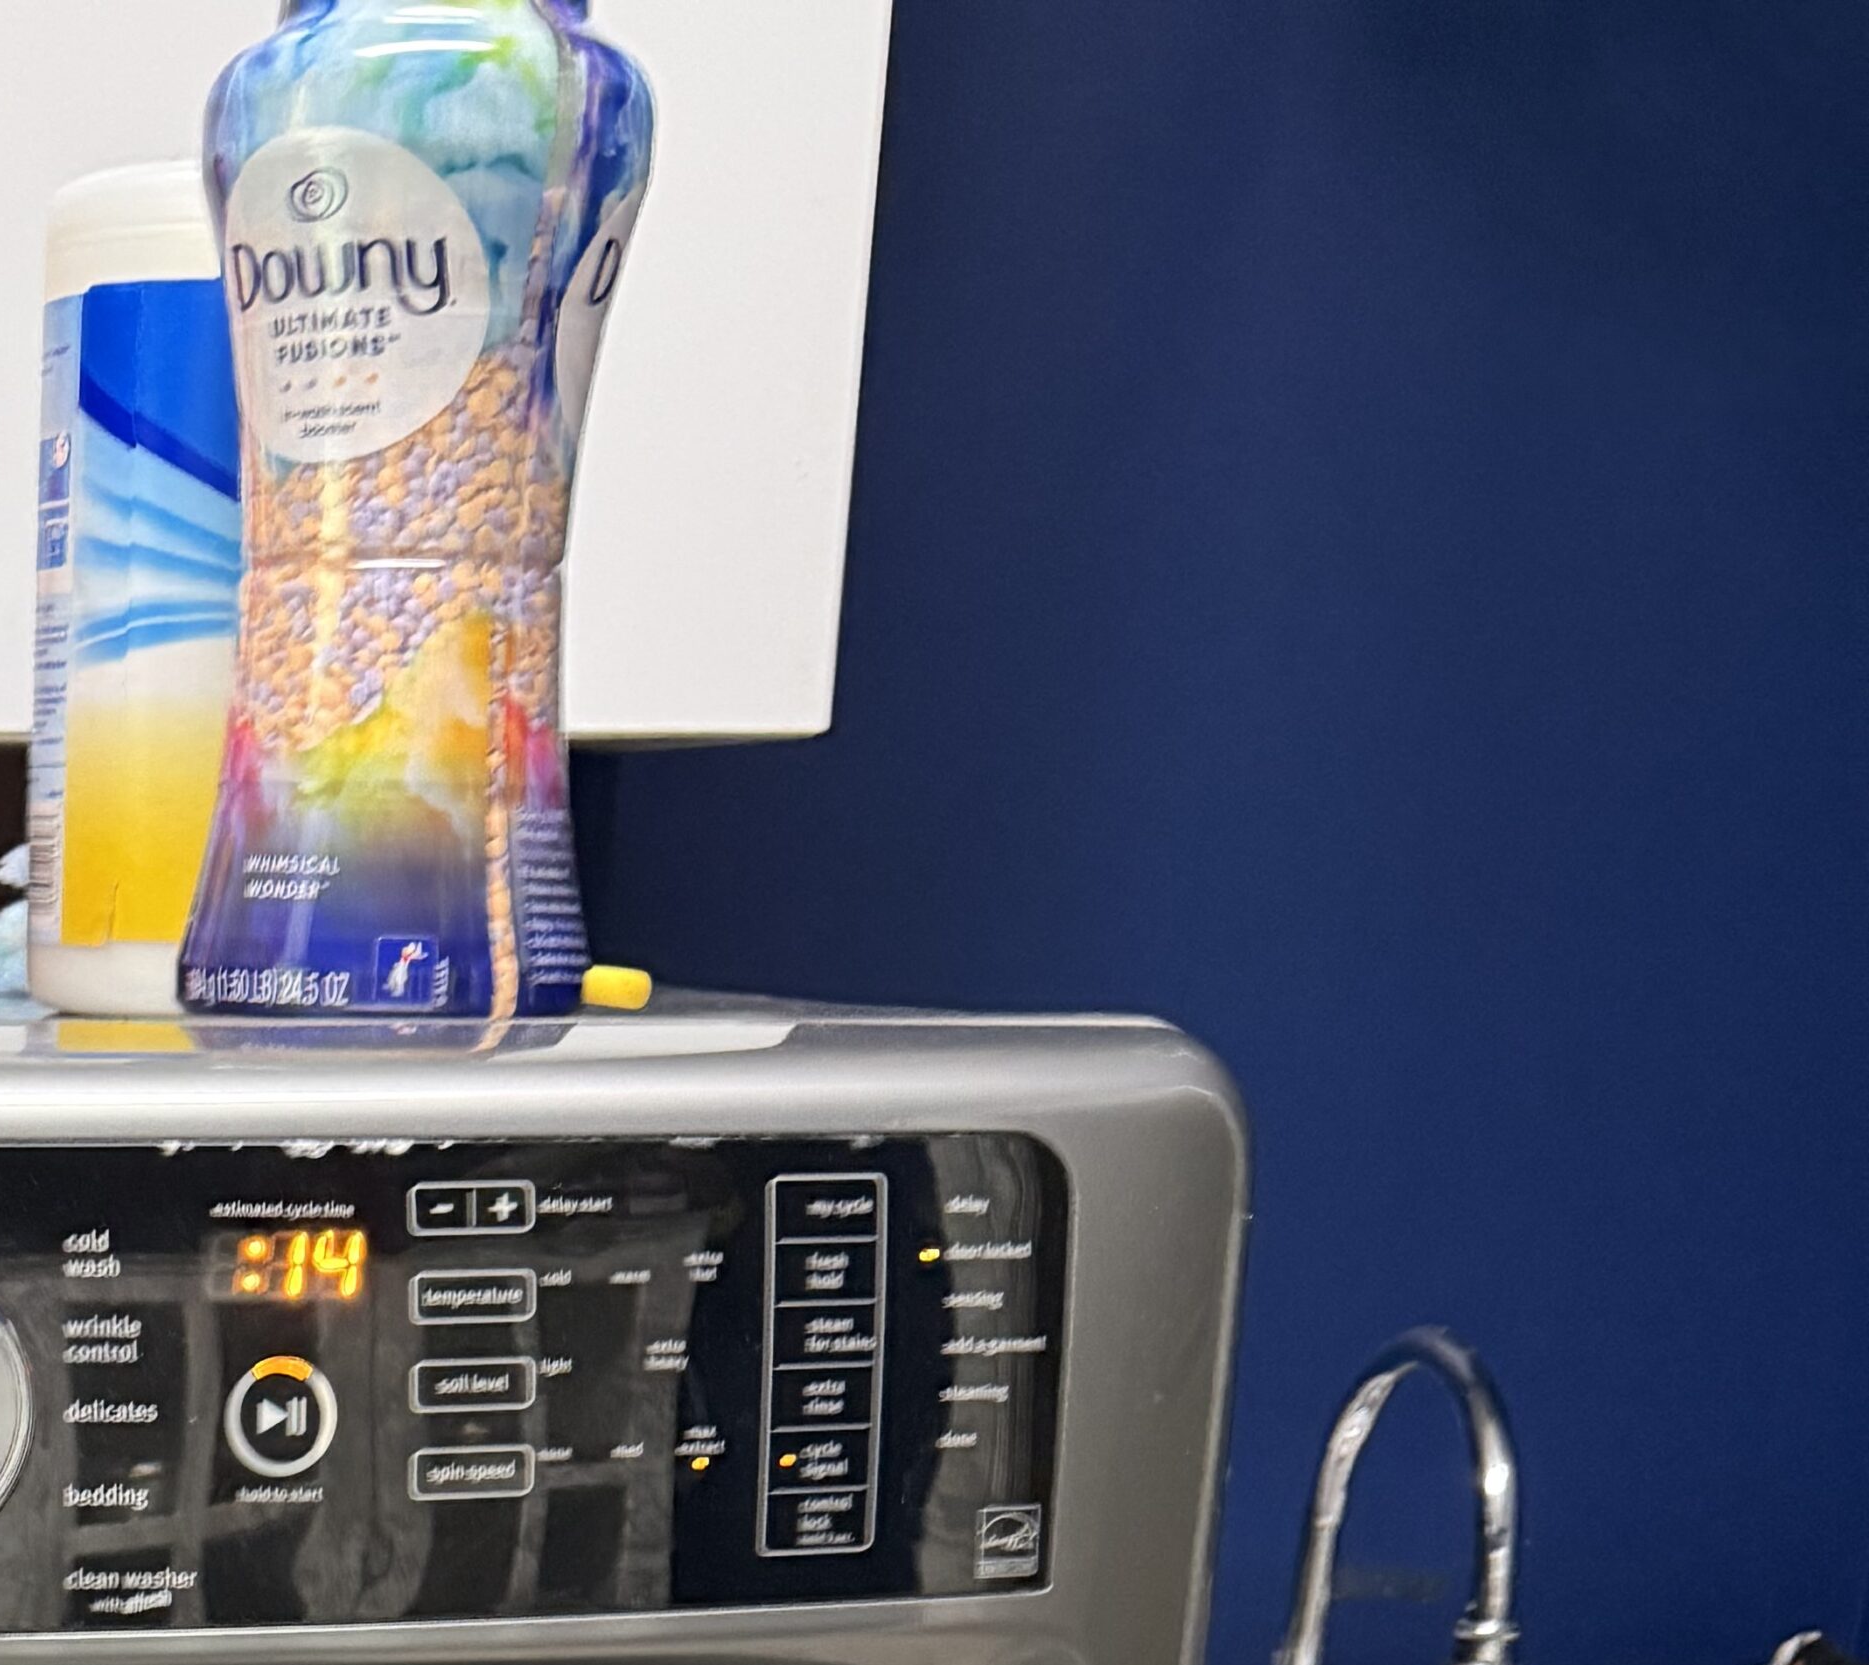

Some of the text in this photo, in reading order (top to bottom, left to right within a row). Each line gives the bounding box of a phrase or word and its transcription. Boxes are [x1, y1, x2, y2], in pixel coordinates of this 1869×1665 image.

[231, 235, 451, 316] Downy
[272, 306, 391, 338] ULTIMATE
[275, 337, 387, 366] FUSIONS
[244, 853, 341, 876] WHIMSICAL
[244, 879, 320, 899] WONDER
[276, 969, 320, 1006] 24.5
[321, 971, 350, 1006] OZ
[210, 1199, 356, 1220] estimated cycle time
[944, 1194, 990, 1216] delay
[62, 1229, 110, 1253] cold
[943, 1239, 1033, 1261] door locked
[63, 1254, 121, 1278] wash
[421, 1286, 523, 1309] temperature
[63, 1315, 142, 1338] wrinkle
[63, 1340, 140, 1363] control
[435, 1372, 510, 1394] soil level
[63, 1399, 159, 1423] delicates
[799, 1440, 843, 1459] cycle
[426, 1459, 516, 1484] spin speed
[799, 1458, 849, 1480] signal
[63, 1483, 150, 1511] bedding
[63, 1567, 198, 1590] clean washer
